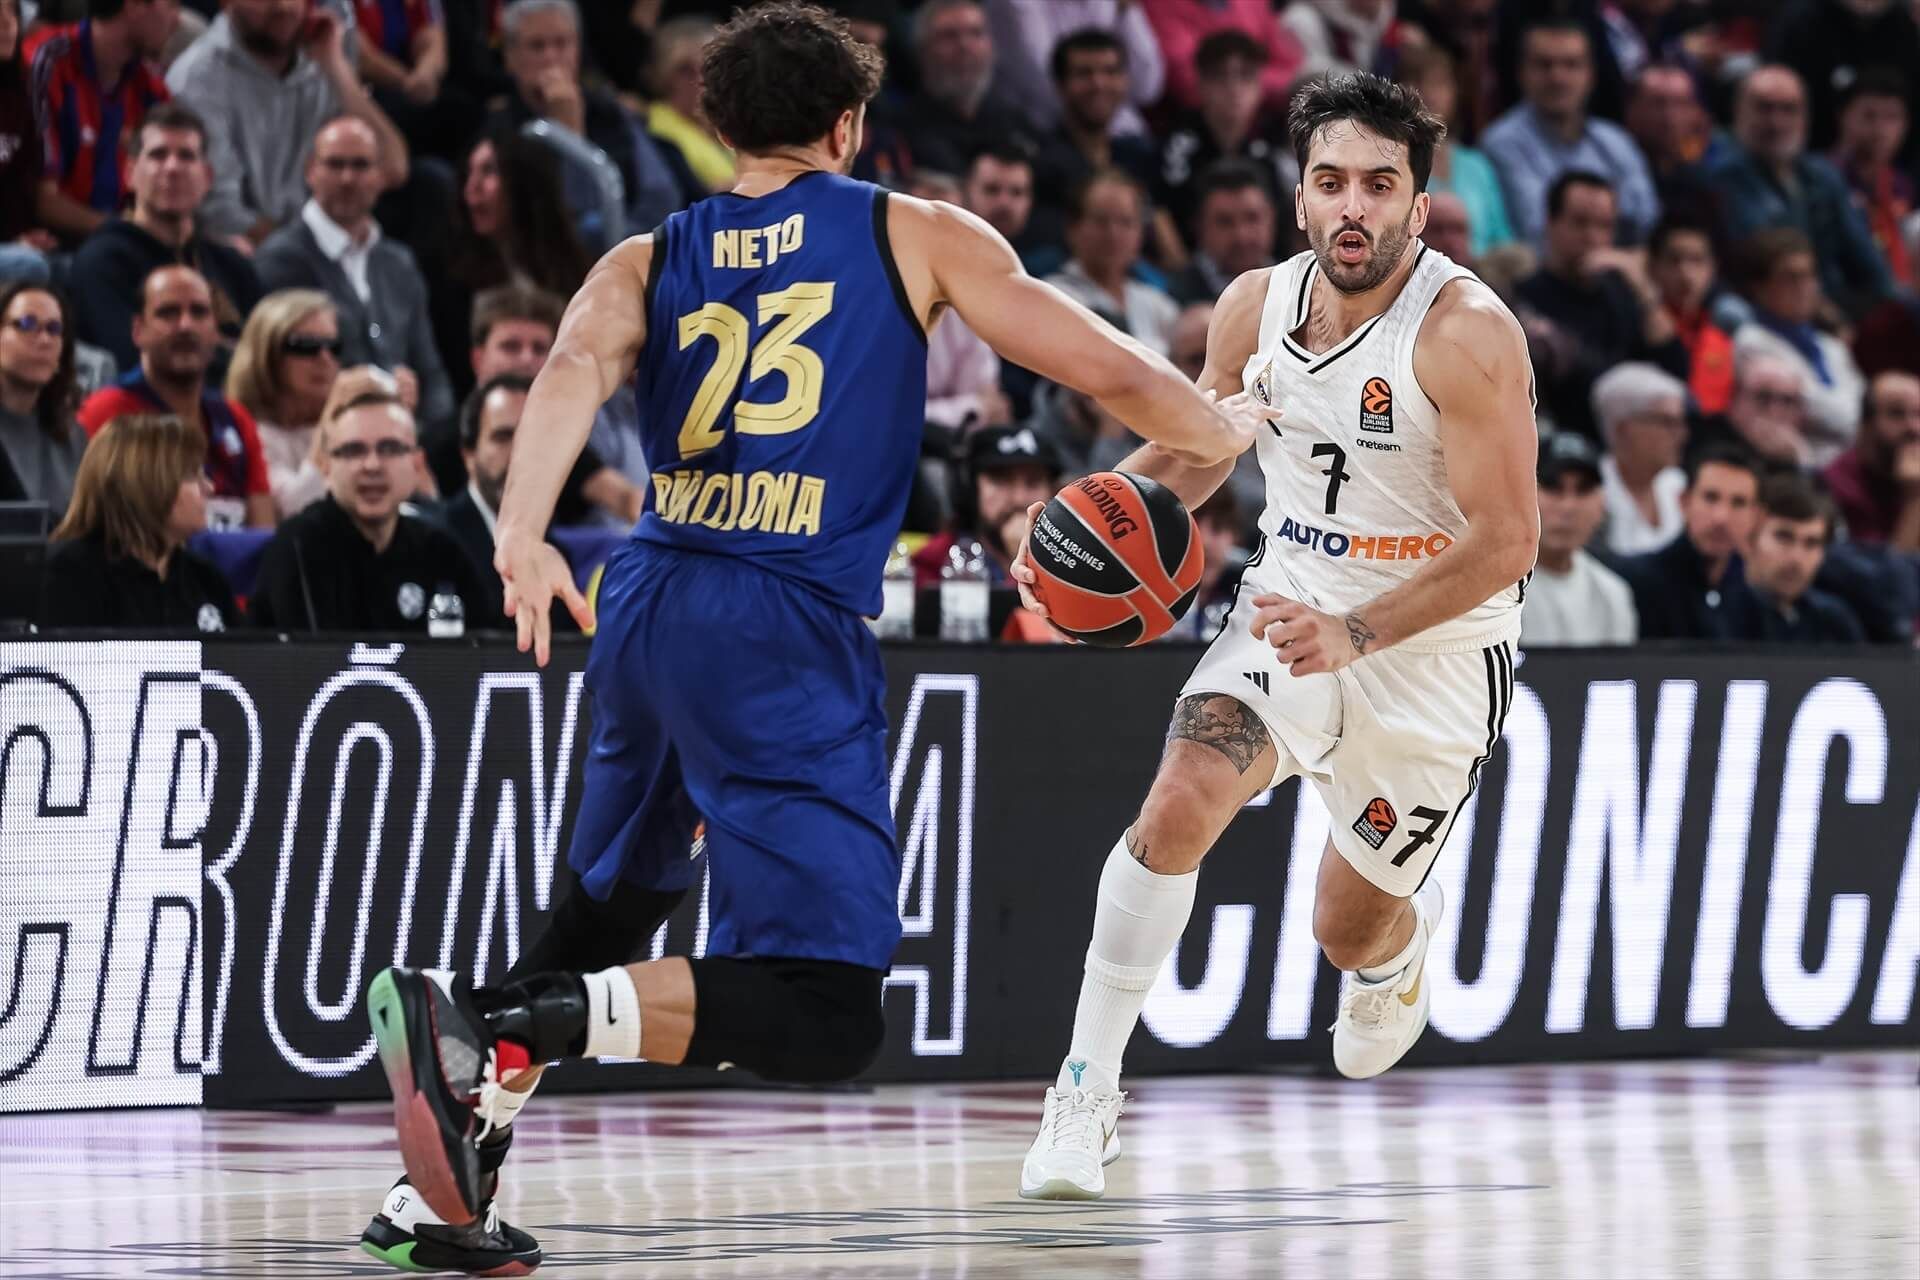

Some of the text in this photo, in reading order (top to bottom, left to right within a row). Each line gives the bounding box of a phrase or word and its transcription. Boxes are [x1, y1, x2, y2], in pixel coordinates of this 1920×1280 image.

[713, 213, 805, 269] NETO
[677, 282, 836, 460] 23
[1362, 412, 1390, 421] TURKISH
[1362, 418, 1390, 427] AIRLINES
[1356, 438, 1402, 452] oneteam
[1311, 443, 1351, 515] 7
[1072, 477, 1138, 540] PALDING
[1060, 538, 1106, 571] AIRLINES
[1277, 517, 1454, 560] AUTOHERO
[1390, 805, 1449, 868] 7
